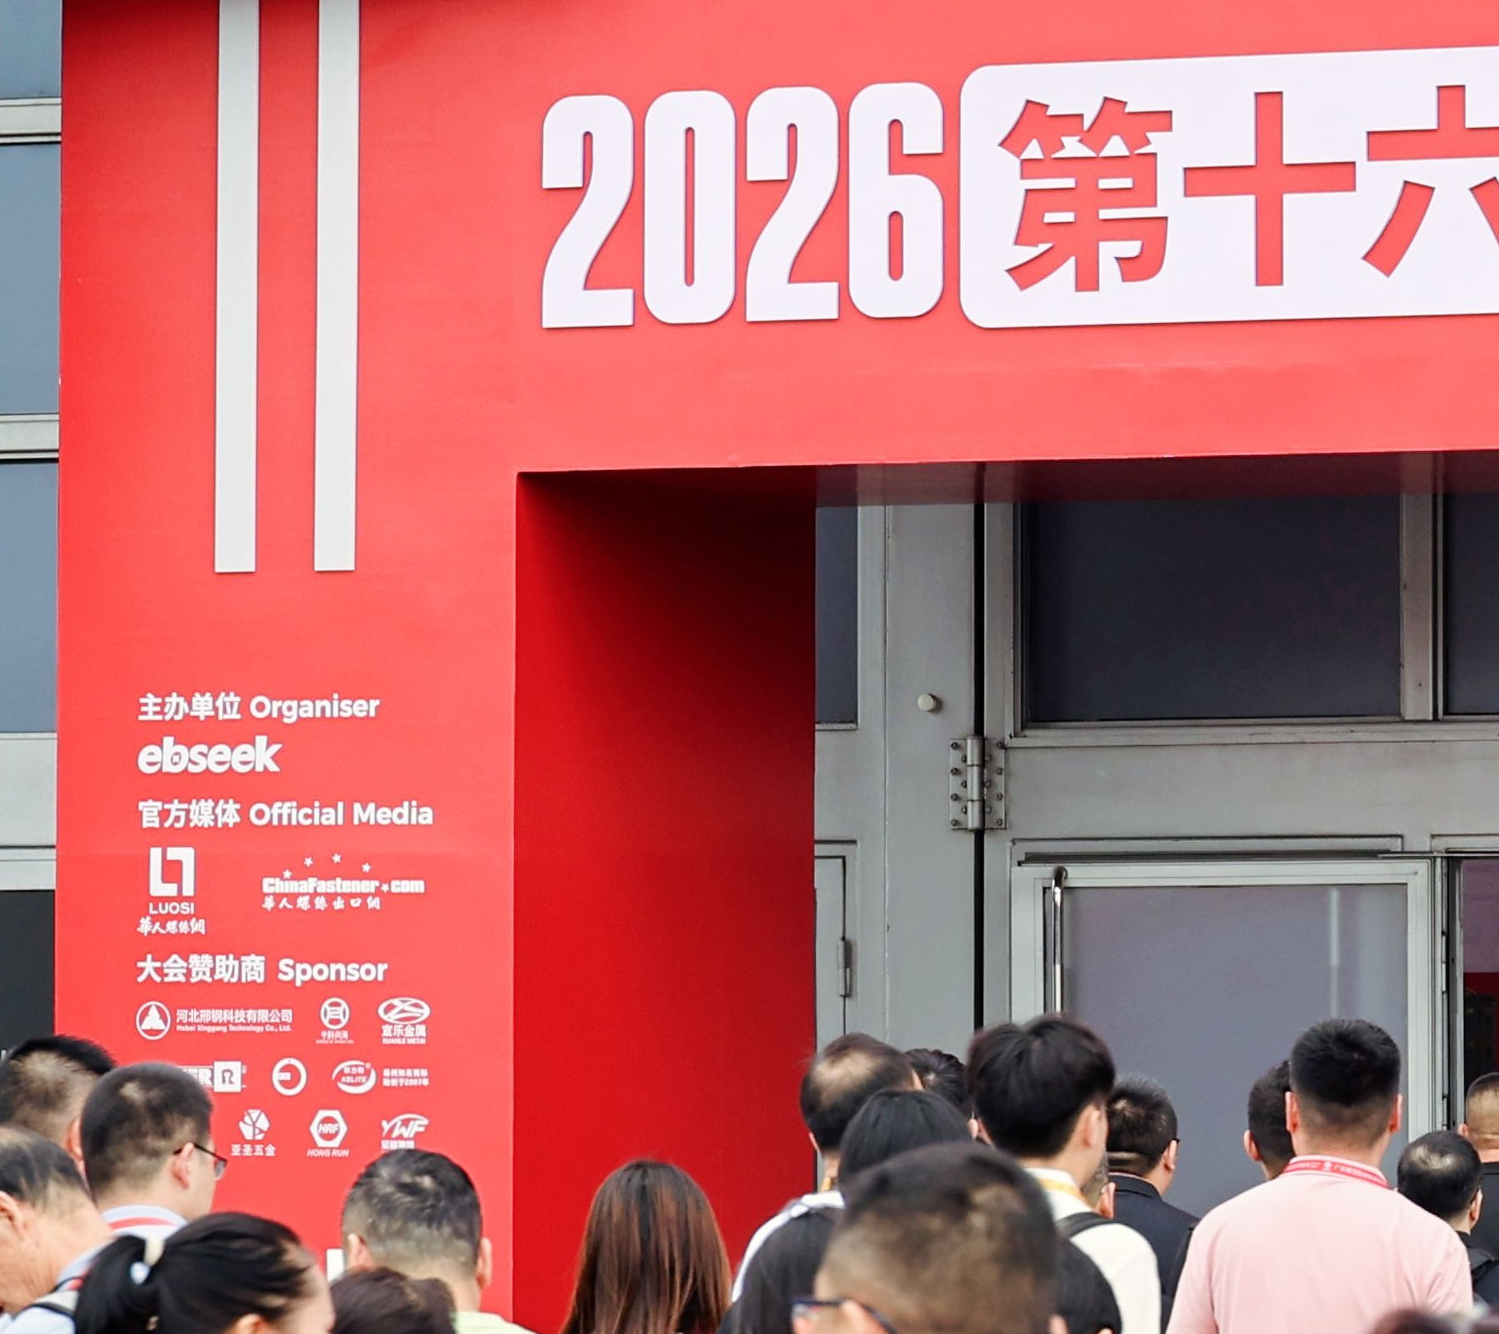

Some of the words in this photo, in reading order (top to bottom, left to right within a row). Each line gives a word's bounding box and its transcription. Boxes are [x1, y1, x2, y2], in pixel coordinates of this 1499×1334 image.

[542, 82, 943, 328] 2026
[138, 692, 242, 721] 主办单位
[249, 693, 380, 723] Organiser
[138, 735, 283, 773] ebseek
[138, 799, 241, 828] 官方媒体
[249, 800, 344, 826] Official
[353, 800, 434, 825] Media
[148, 902, 195, 915] LUOSI
[137, 954, 266, 983] 大会赞助商
[278, 958, 388, 987] Sponsor
[318, 1122, 341, 1134] HRF
[307, 1148, 331, 1158] HONG
[331, 1149, 350, 1158] RUN
